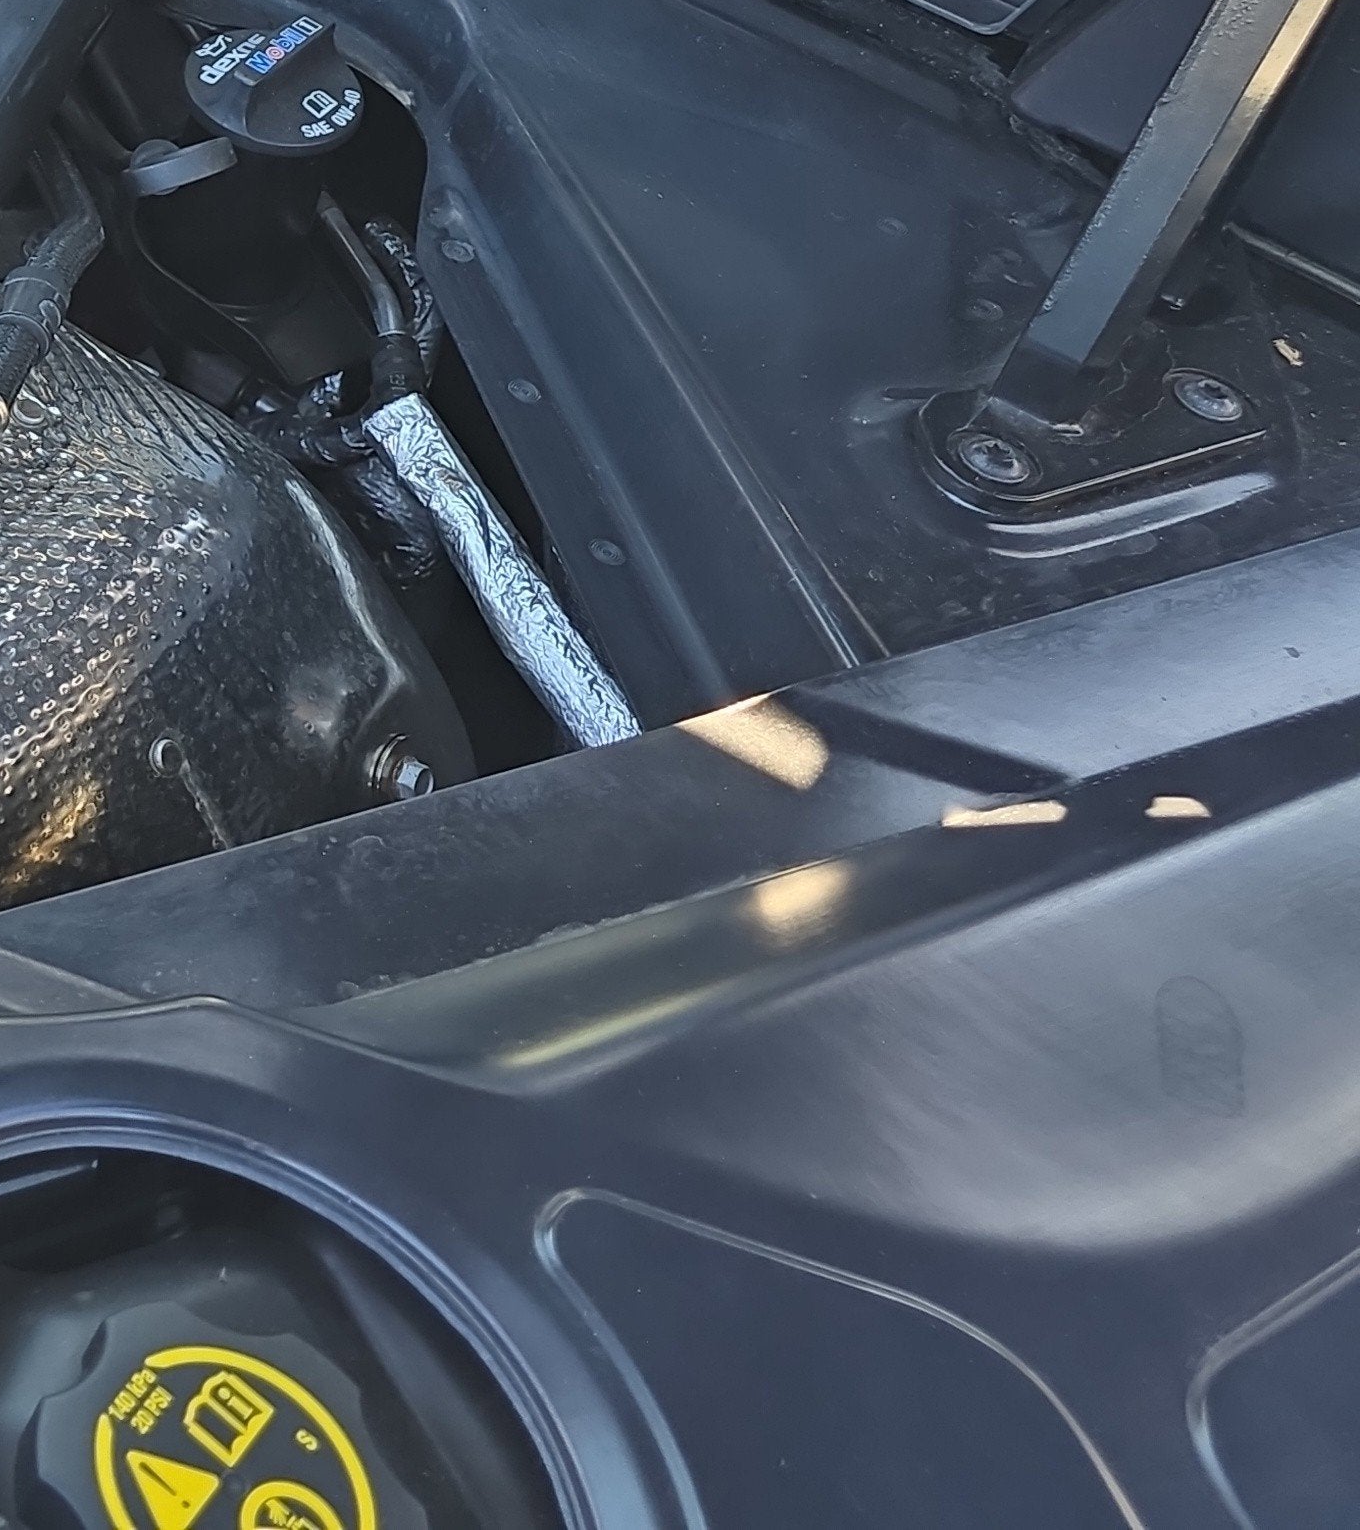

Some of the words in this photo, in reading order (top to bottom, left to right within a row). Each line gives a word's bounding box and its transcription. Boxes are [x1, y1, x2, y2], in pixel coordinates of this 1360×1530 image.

[245, 27, 307, 74] Mobil
[300, 120, 335, 138] SAE
[330, 89, 361, 127] 0W-40
[108, 1391, 136, 1420] 140
[126, 1368, 157, 1399] kPa
[130, 1407, 155, 1435] 20
[143, 1385, 175, 1416] PSI
